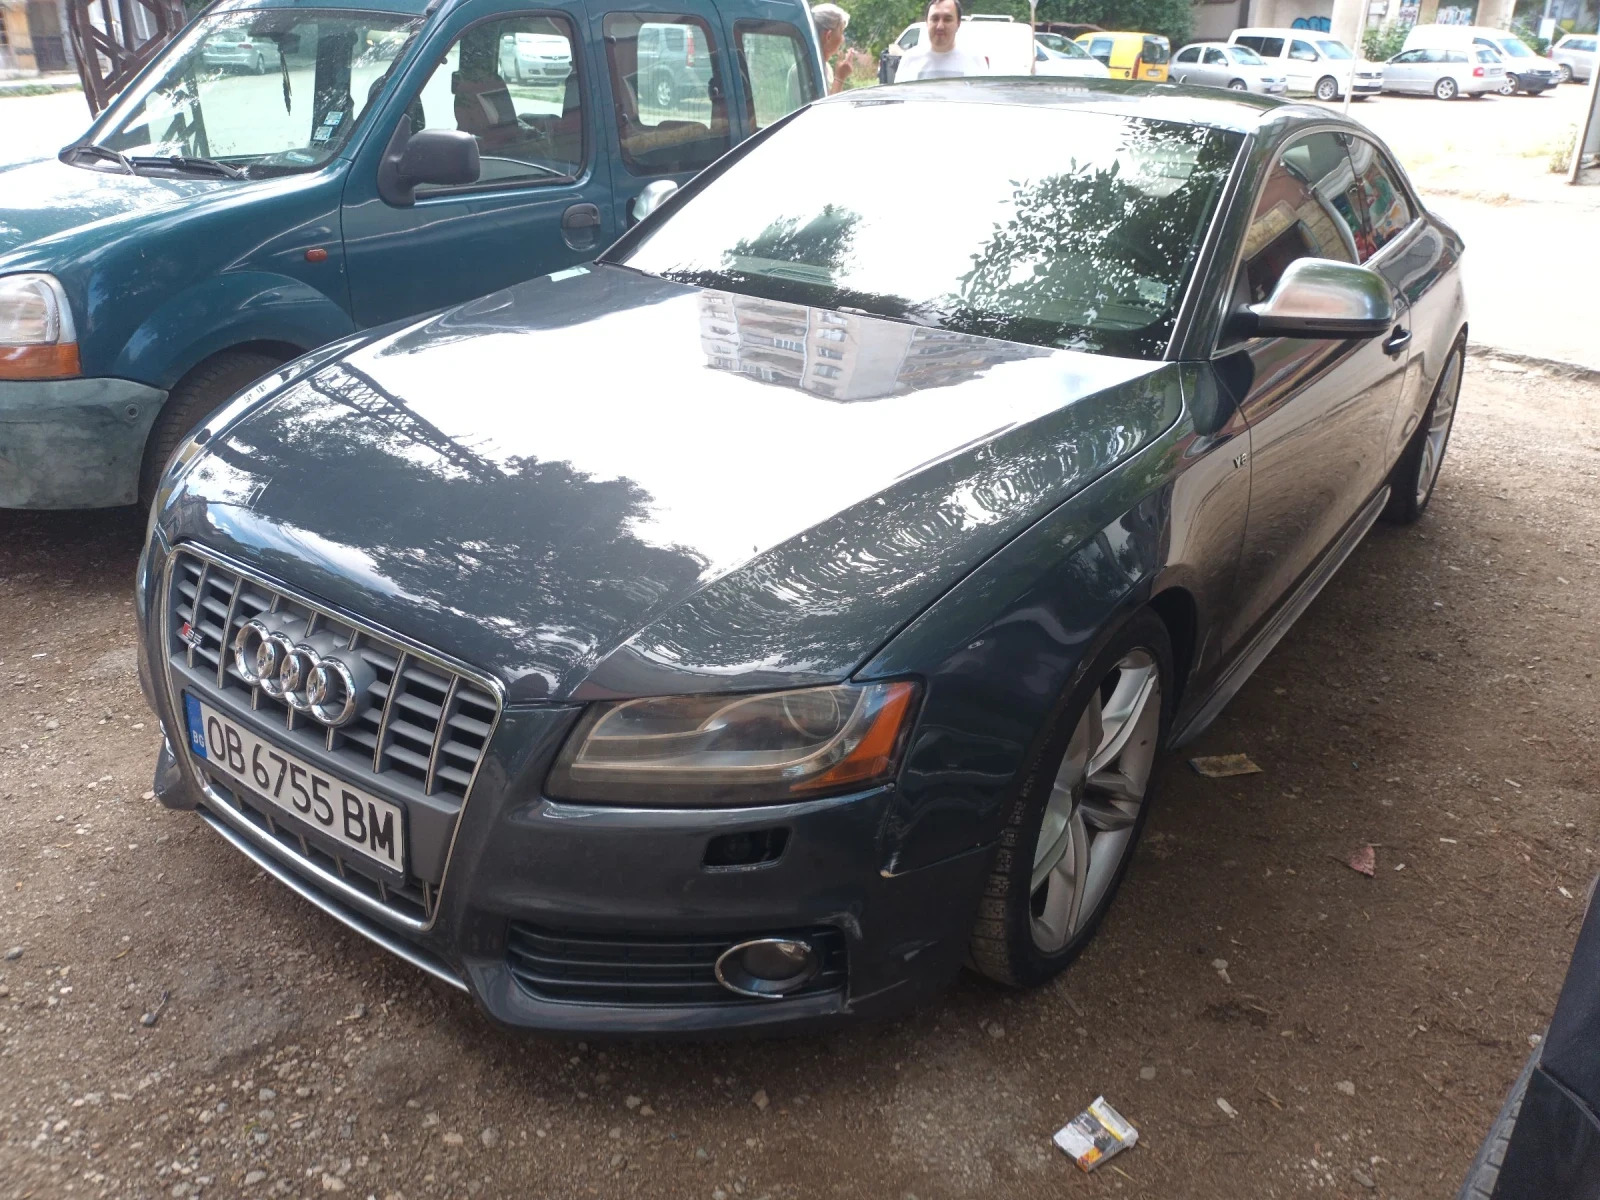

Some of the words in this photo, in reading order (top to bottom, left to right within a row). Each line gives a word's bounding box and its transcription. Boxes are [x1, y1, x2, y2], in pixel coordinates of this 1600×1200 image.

[1233, 452, 1247, 469] V8
[192, 729, 205, 748] BG
[207, 715, 245, 775] OB
[252, 743, 334, 827] 6755
[341, 789, 395, 861] BM
